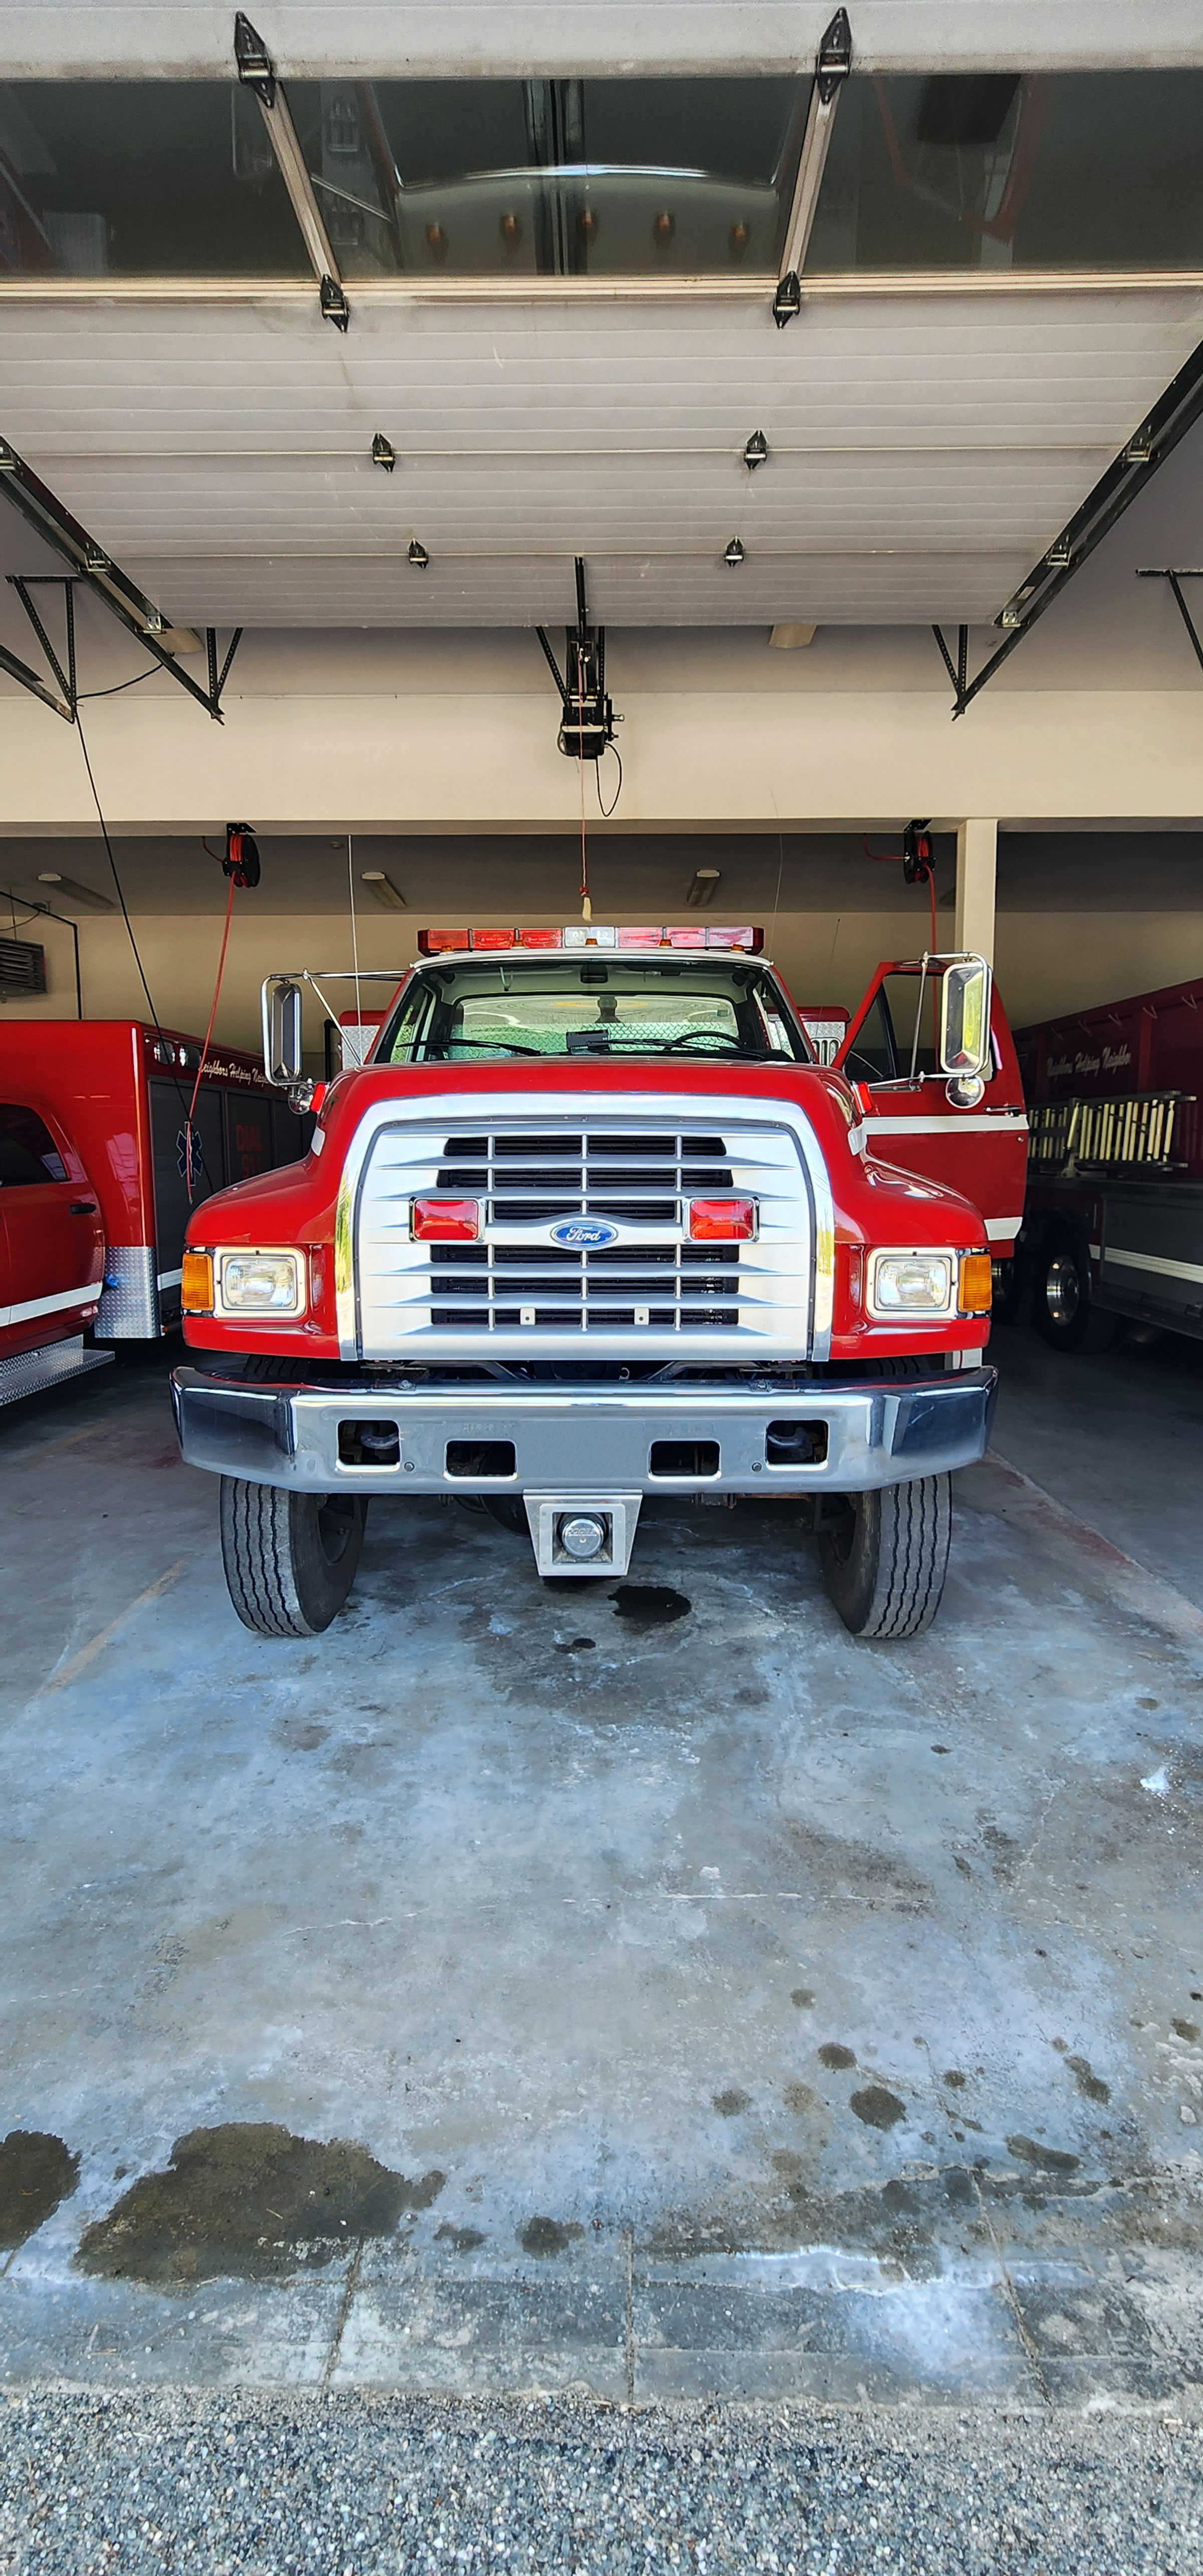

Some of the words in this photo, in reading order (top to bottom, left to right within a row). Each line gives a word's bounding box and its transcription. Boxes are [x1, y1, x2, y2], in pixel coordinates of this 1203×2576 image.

[198, 1060, 229, 1079] eighbors
[229, 1063, 251, 1085] Helping
[252, 1068, 269, 1088] Neig
[236, 1124, 264, 1152] DIAL
[242, 1153, 264, 1178] 911
[566, 1226, 601, 1241] Ford
